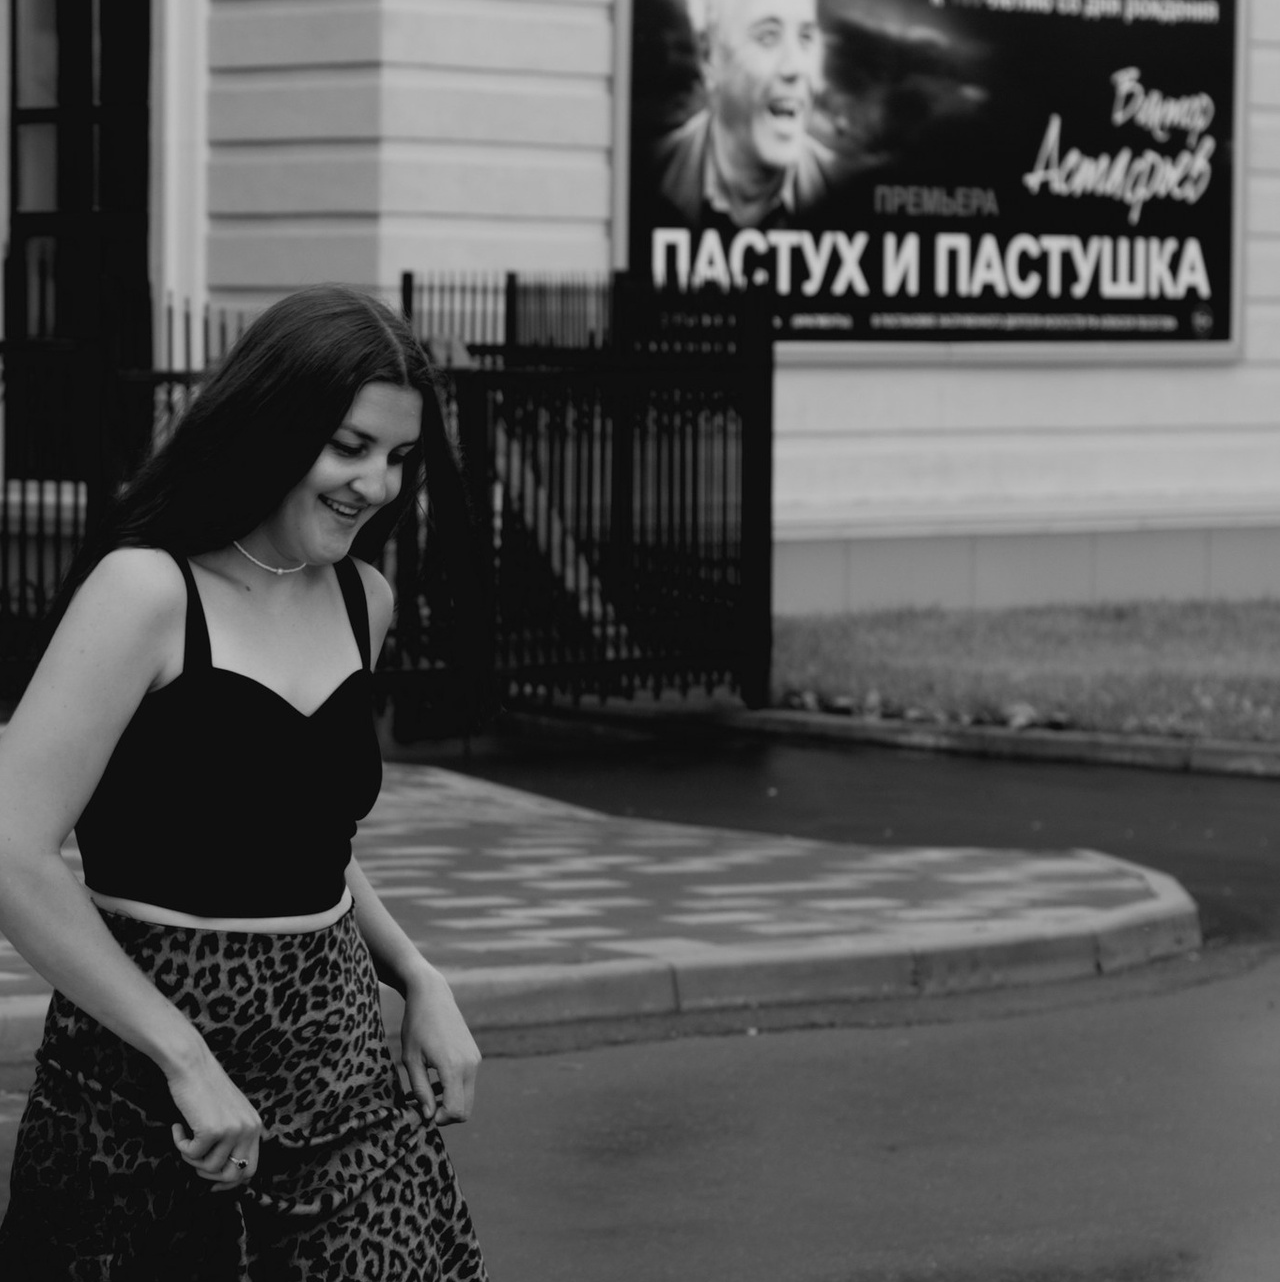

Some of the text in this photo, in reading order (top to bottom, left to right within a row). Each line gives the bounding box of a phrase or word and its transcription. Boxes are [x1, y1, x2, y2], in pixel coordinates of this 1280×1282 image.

[873, 184, 1000, 217] ПРЕМЬЕРА
[651, 227, 1212, 300] ПАСТУХ И ПАСТУШКА
